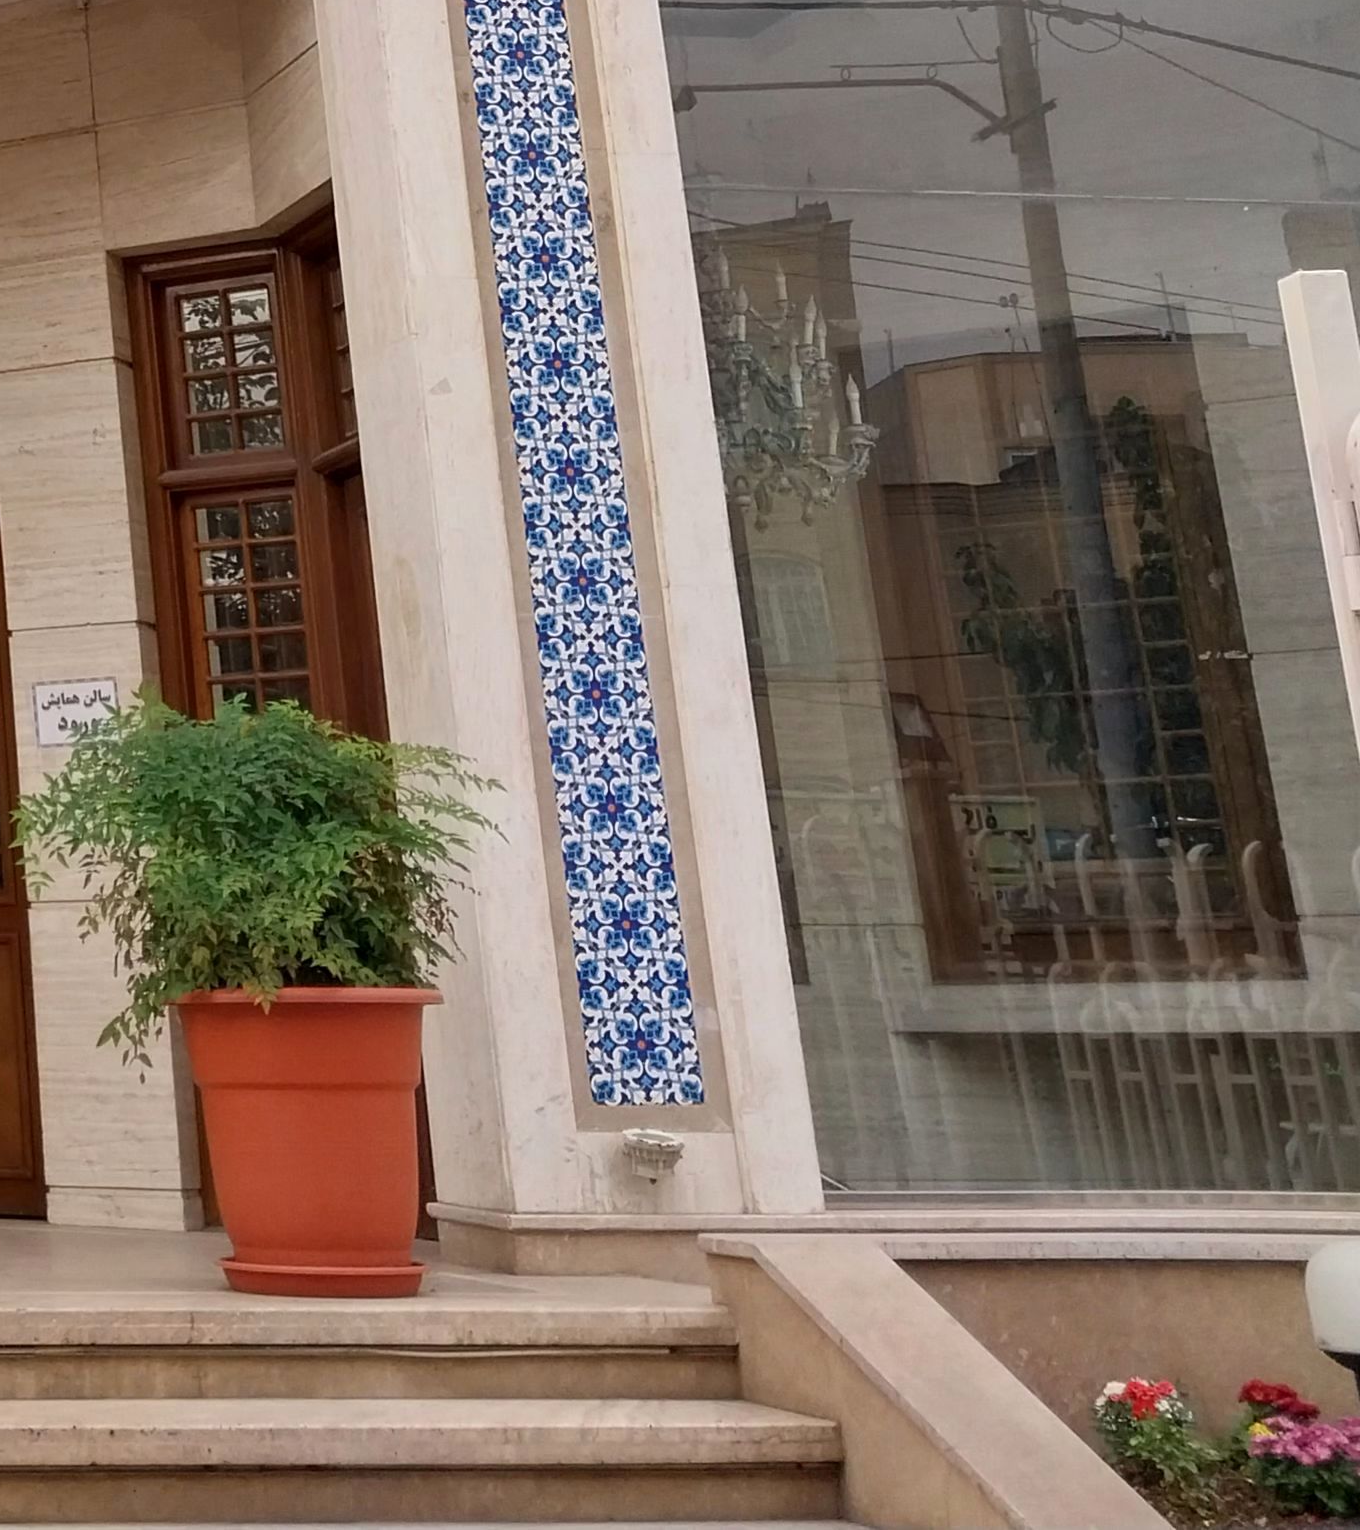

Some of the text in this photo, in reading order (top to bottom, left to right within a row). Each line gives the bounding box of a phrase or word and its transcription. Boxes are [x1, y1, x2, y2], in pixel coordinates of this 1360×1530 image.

[41, 689, 112, 710] سالن همایش
[58, 716, 101, 737] رود
